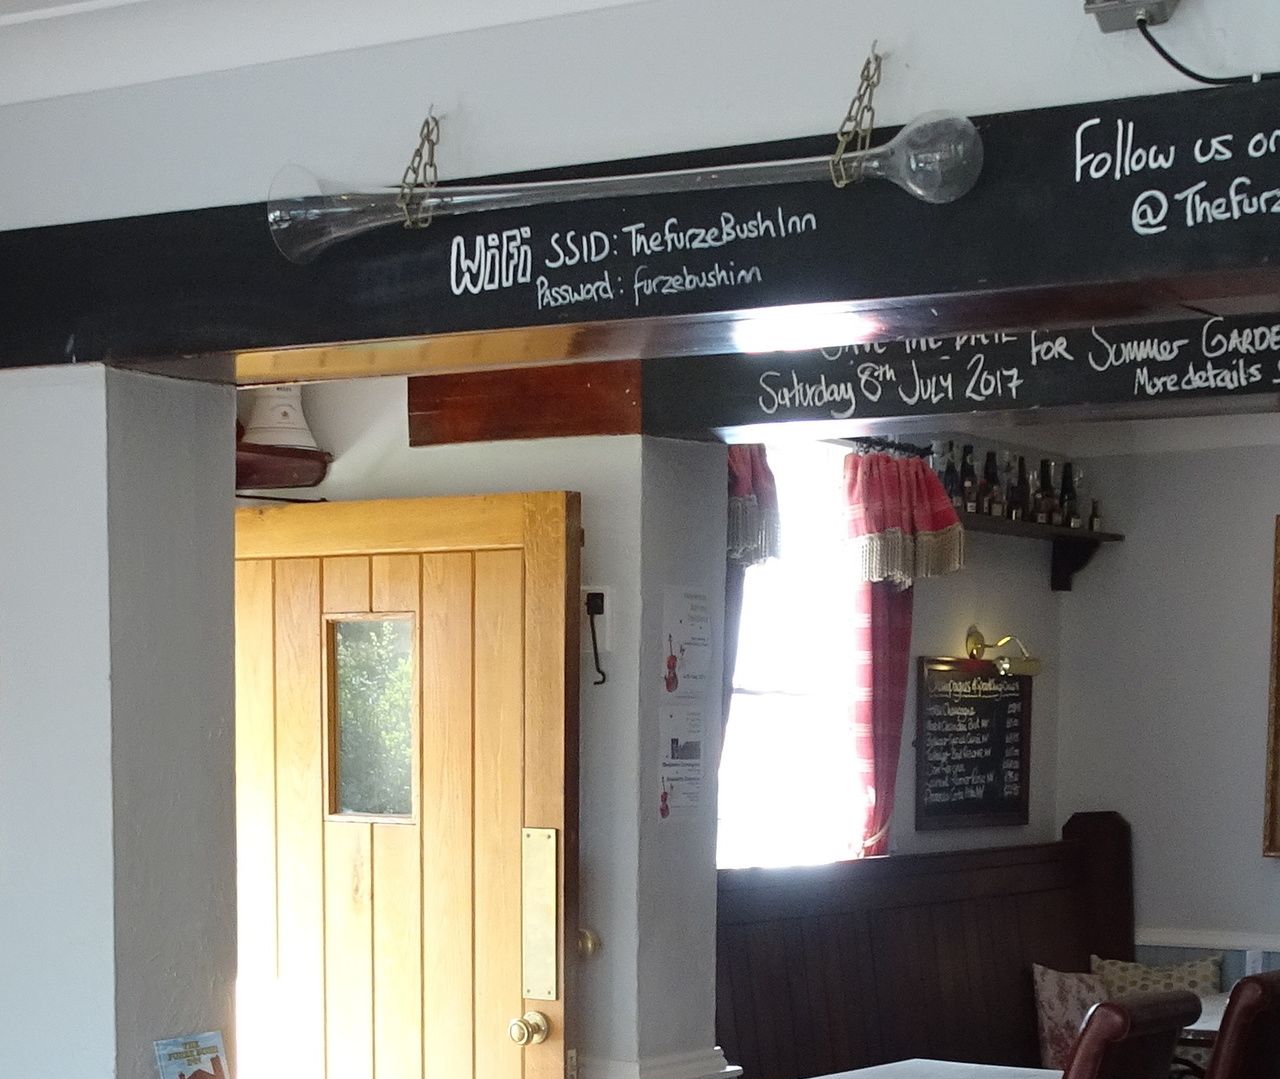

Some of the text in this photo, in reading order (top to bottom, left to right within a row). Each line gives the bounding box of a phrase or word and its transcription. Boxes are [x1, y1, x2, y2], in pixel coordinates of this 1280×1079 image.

[1075, 118, 1175, 183] Follow
[1193, 133, 1234, 163] us
[449, 226, 533, 296] WiFi
[544, 230, 618, 269] SSID:
[758, 369, 856, 419] Saturday
[964, 353, 1025, 401] 2017
